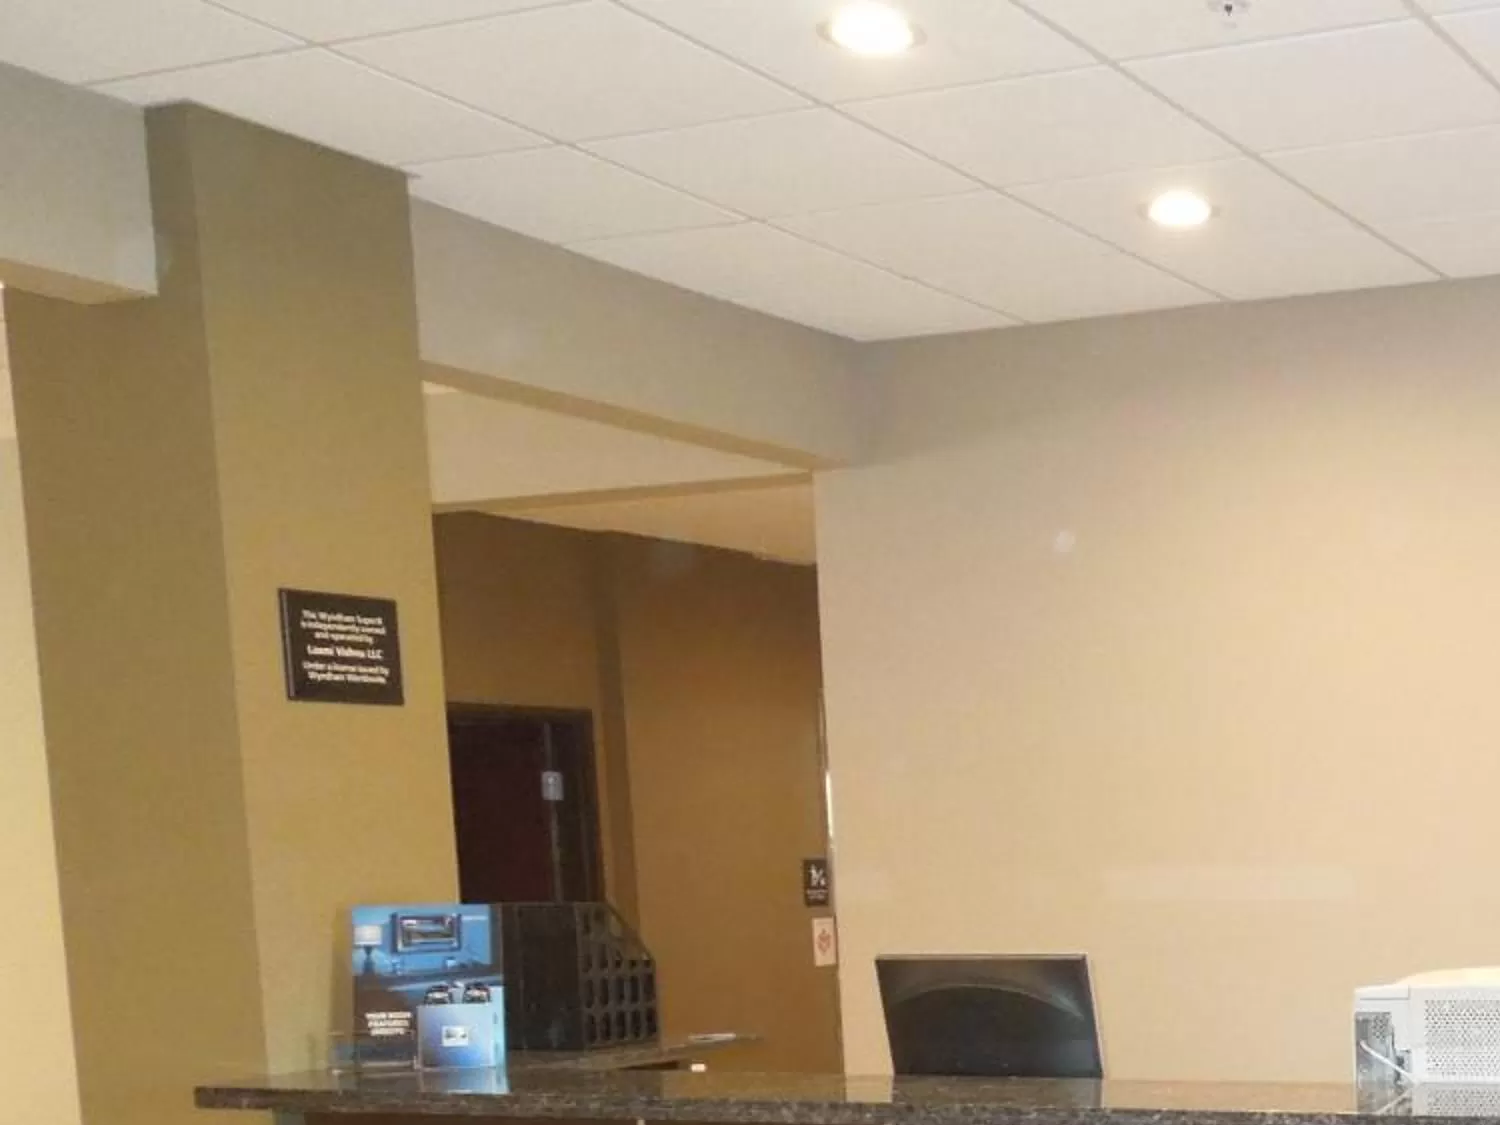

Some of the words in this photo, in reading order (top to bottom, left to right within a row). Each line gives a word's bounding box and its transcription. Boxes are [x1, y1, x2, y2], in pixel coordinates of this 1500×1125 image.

[302, 609, 316, 620] The
[317, 611, 355, 623] Wyndham
[314, 631, 329, 640] and
[367, 648, 384, 660] LLC
[307, 670, 345, 682] Wyndham
